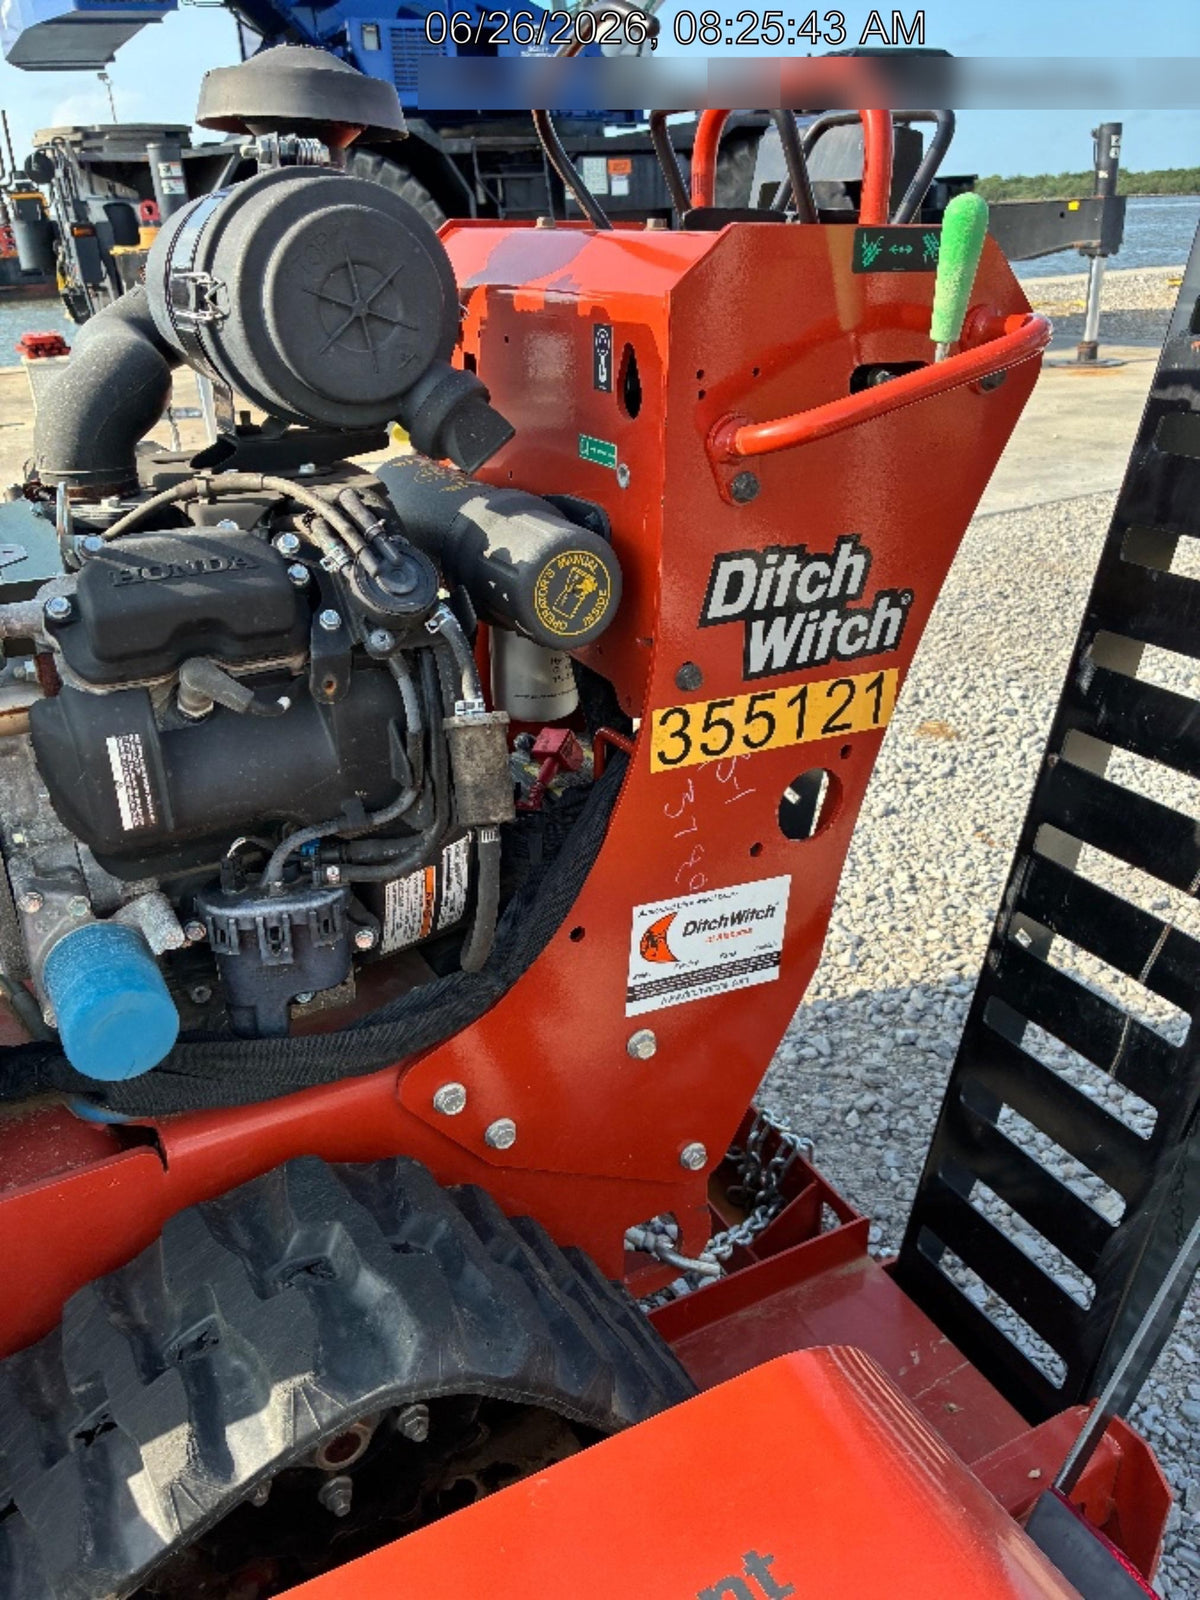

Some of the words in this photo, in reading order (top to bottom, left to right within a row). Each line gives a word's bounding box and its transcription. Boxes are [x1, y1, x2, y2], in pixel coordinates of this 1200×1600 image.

[107, 556, 258, 587] HONDA
[582, 589, 607, 628] INSIDE
[705, 541, 868, 620] Ditch
[748, 596, 903, 674] Witch
[657, 671, 884, 765] 355121
